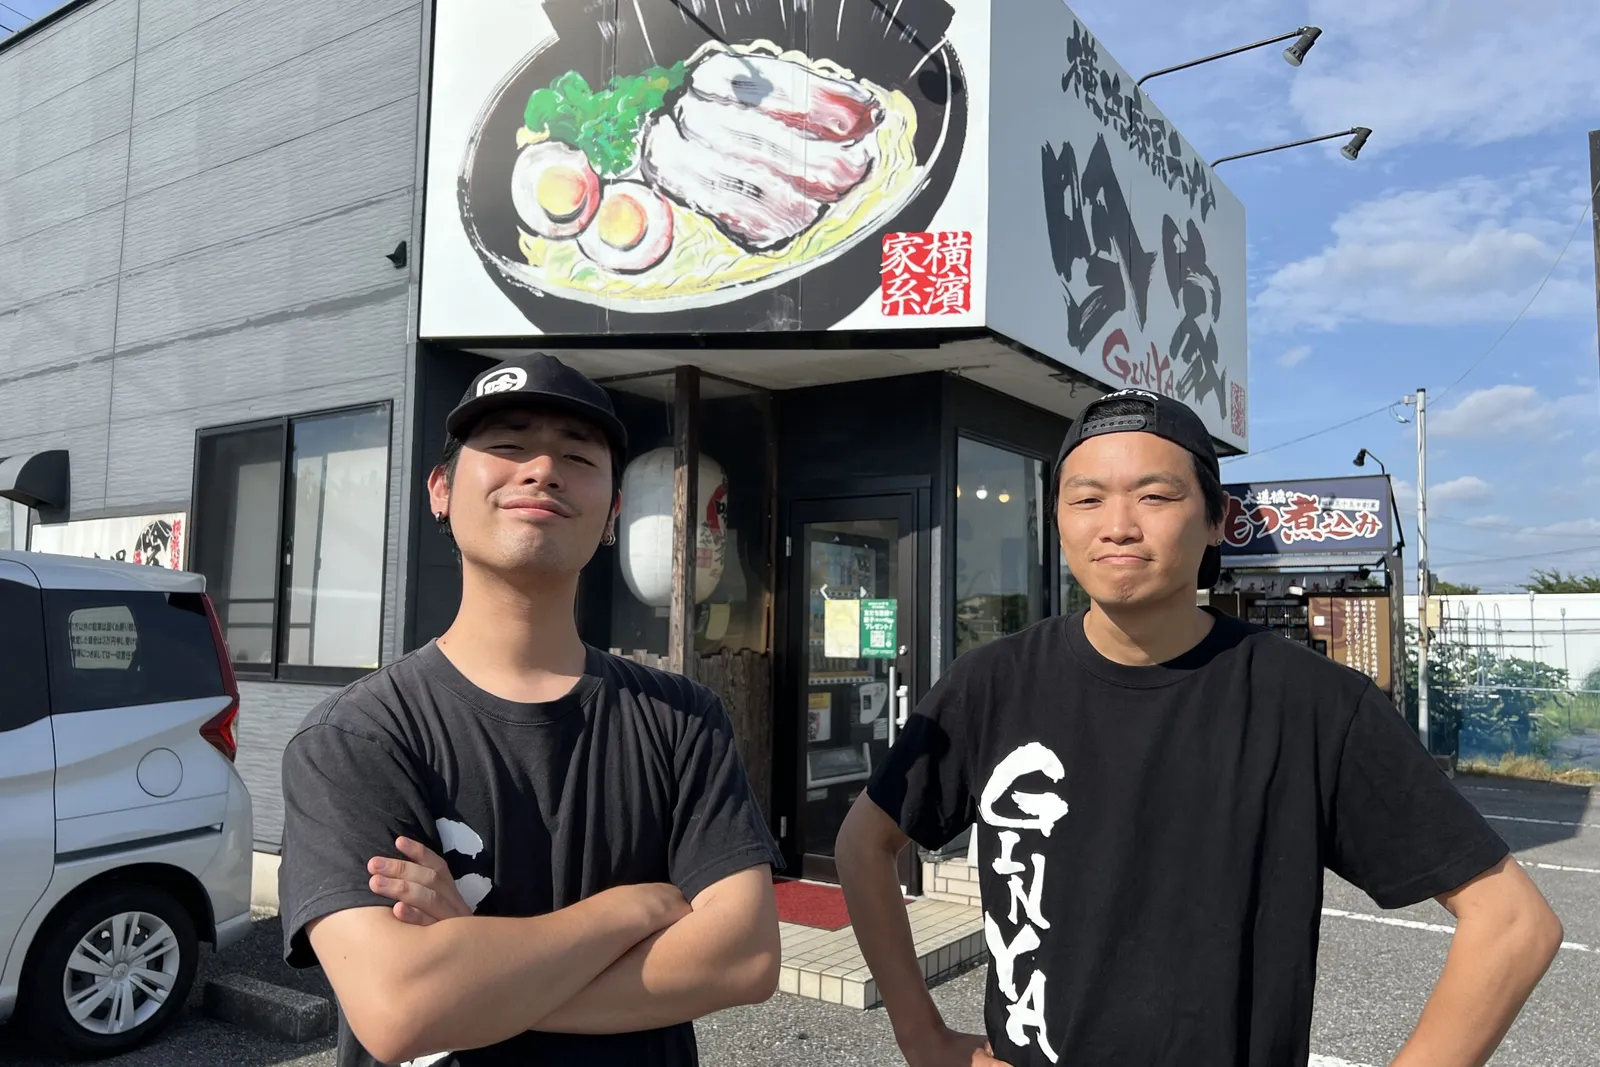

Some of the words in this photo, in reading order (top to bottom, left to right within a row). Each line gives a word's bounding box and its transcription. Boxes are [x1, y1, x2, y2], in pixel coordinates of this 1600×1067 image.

[1224, 493, 1384, 548] もつ煮込み
